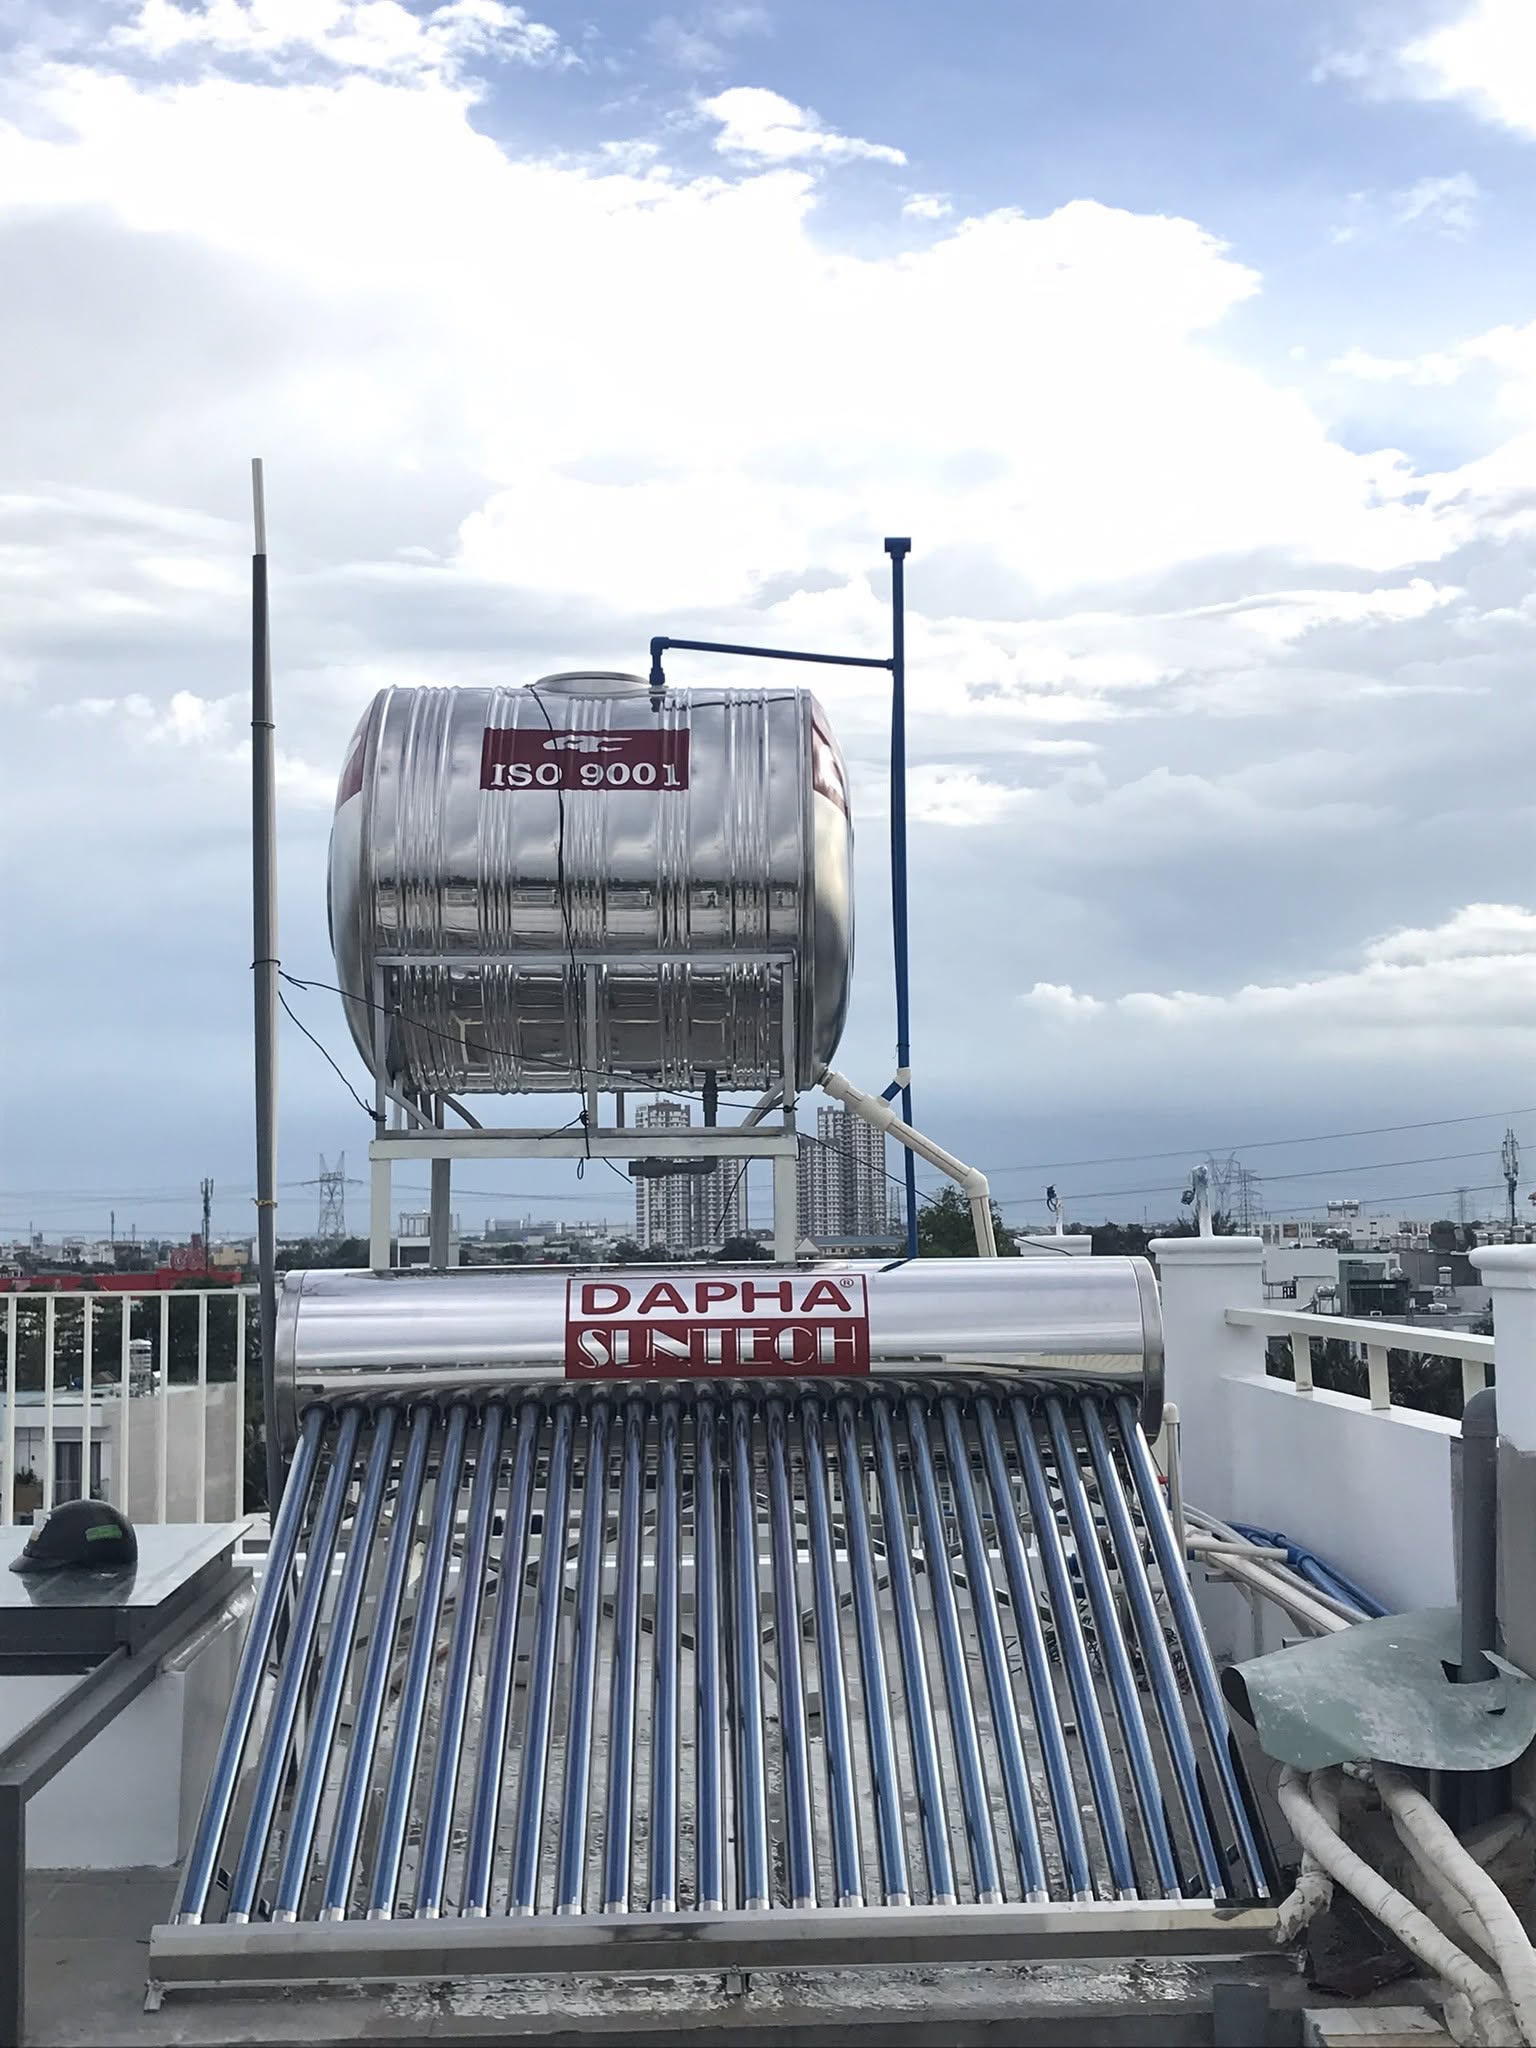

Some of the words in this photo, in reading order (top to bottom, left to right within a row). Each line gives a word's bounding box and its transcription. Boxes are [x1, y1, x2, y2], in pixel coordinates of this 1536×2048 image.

[490, 763, 563, 786] ISO
[580, 762, 680, 786] 9001
[577, 1326, 857, 1369] SUNTECH
